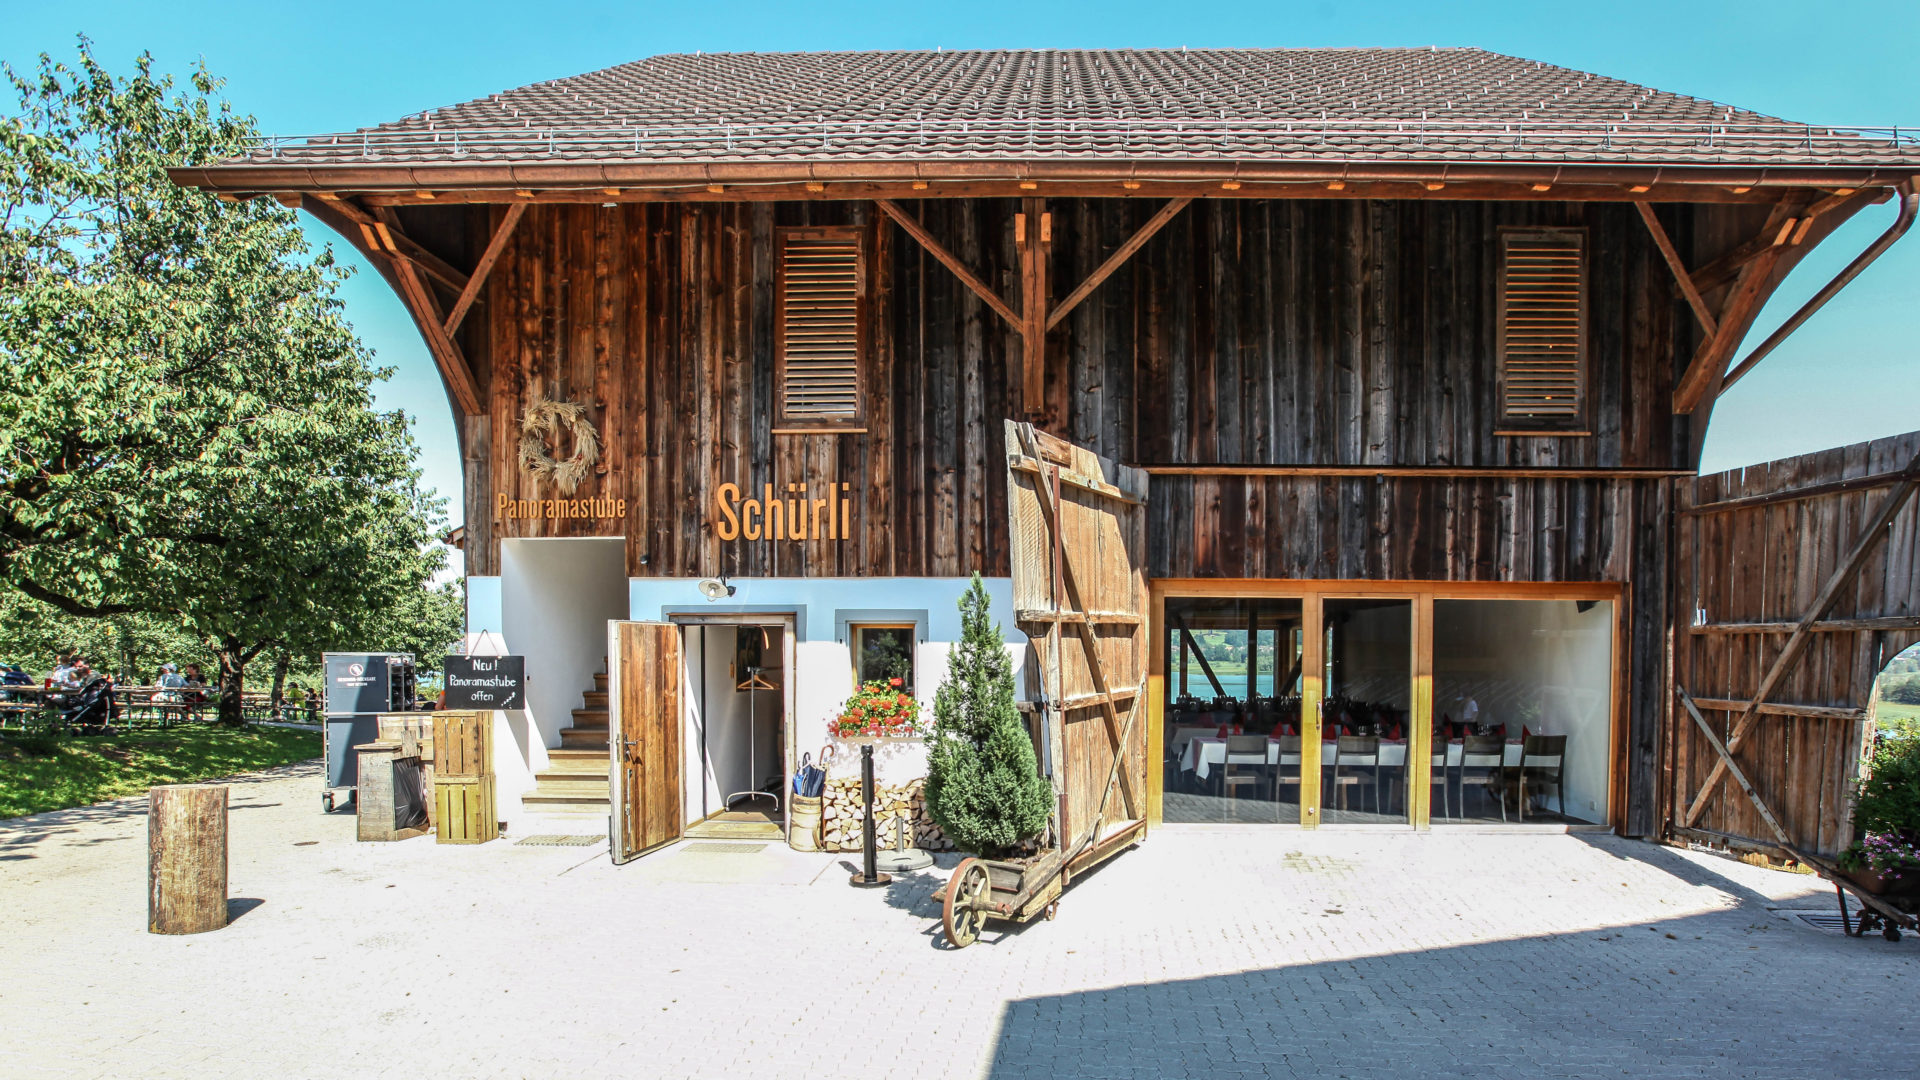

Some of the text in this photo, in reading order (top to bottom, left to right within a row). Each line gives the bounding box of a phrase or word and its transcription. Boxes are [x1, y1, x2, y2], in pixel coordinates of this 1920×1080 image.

[498, 492, 626, 519] Panoramastube
[717, 482, 850, 541] Schürli
[449, 674, 516, 687] Panoramastube
[471, 690, 494, 701] offen
